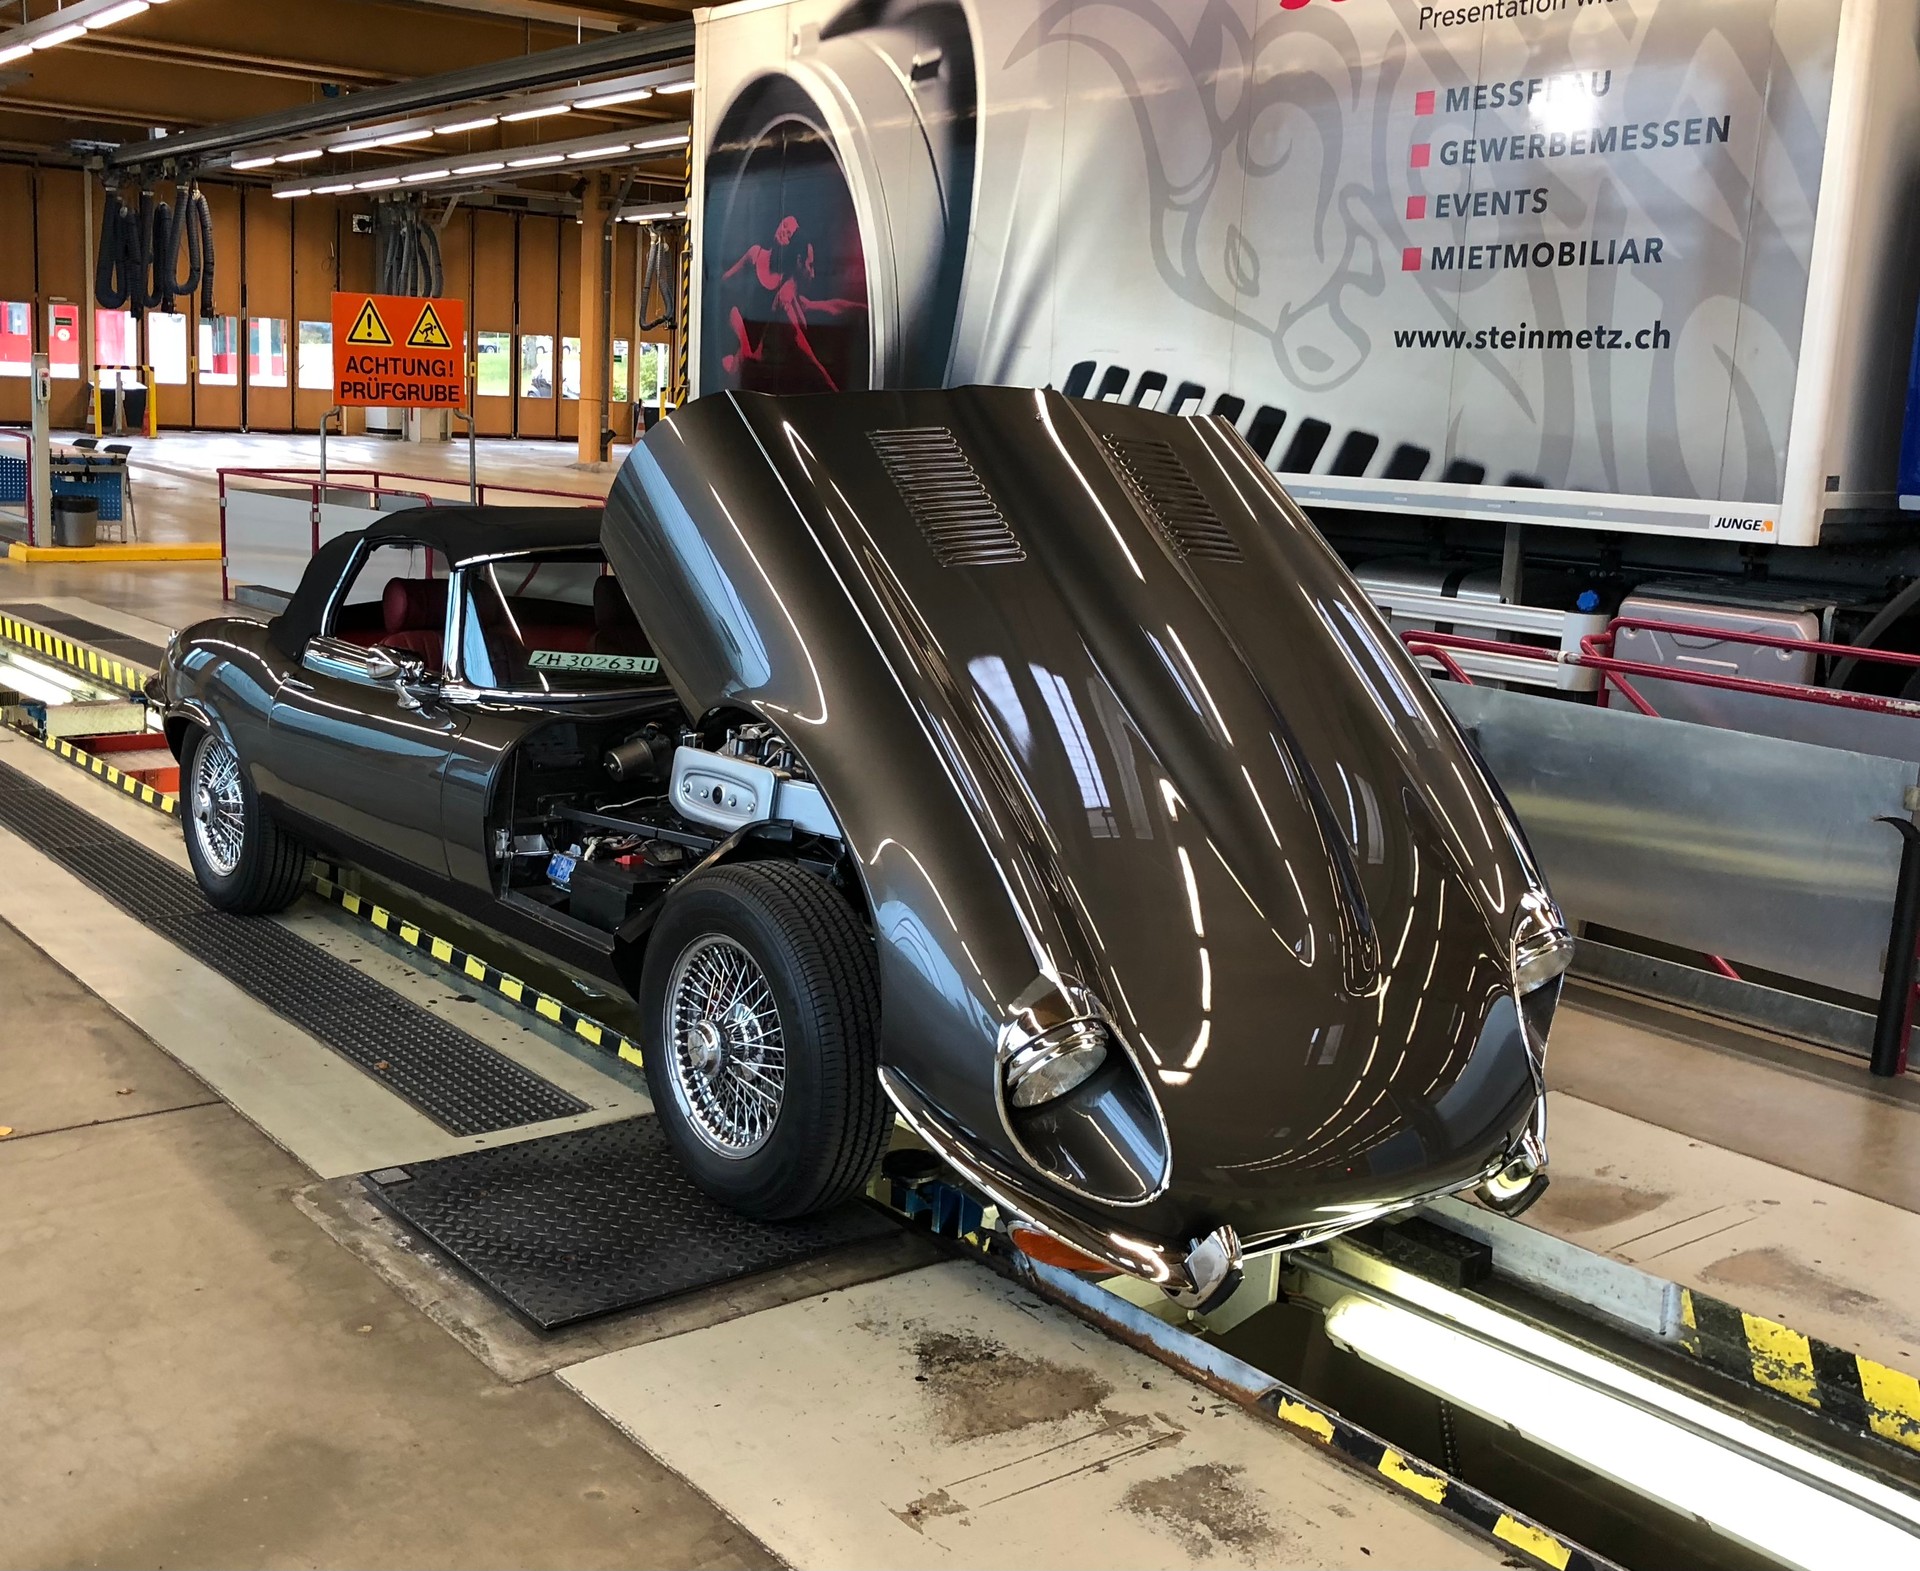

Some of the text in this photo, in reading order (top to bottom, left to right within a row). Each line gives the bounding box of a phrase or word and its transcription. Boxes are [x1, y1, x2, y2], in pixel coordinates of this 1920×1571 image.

[1440, 115, 1731, 166] GEWERBEMESSEN
[1435, 188, 1549, 218] EVENTS
[1431, 237, 1664, 270] MIETMOBILIAR
[1394, 321, 1671, 349] www.steinmetz.ch
[345, 355, 454, 378] ACHTUNG!
[340, 376, 460, 402] PRÜFGRUBE
[1714, 517, 1762, 531] JUNGE
